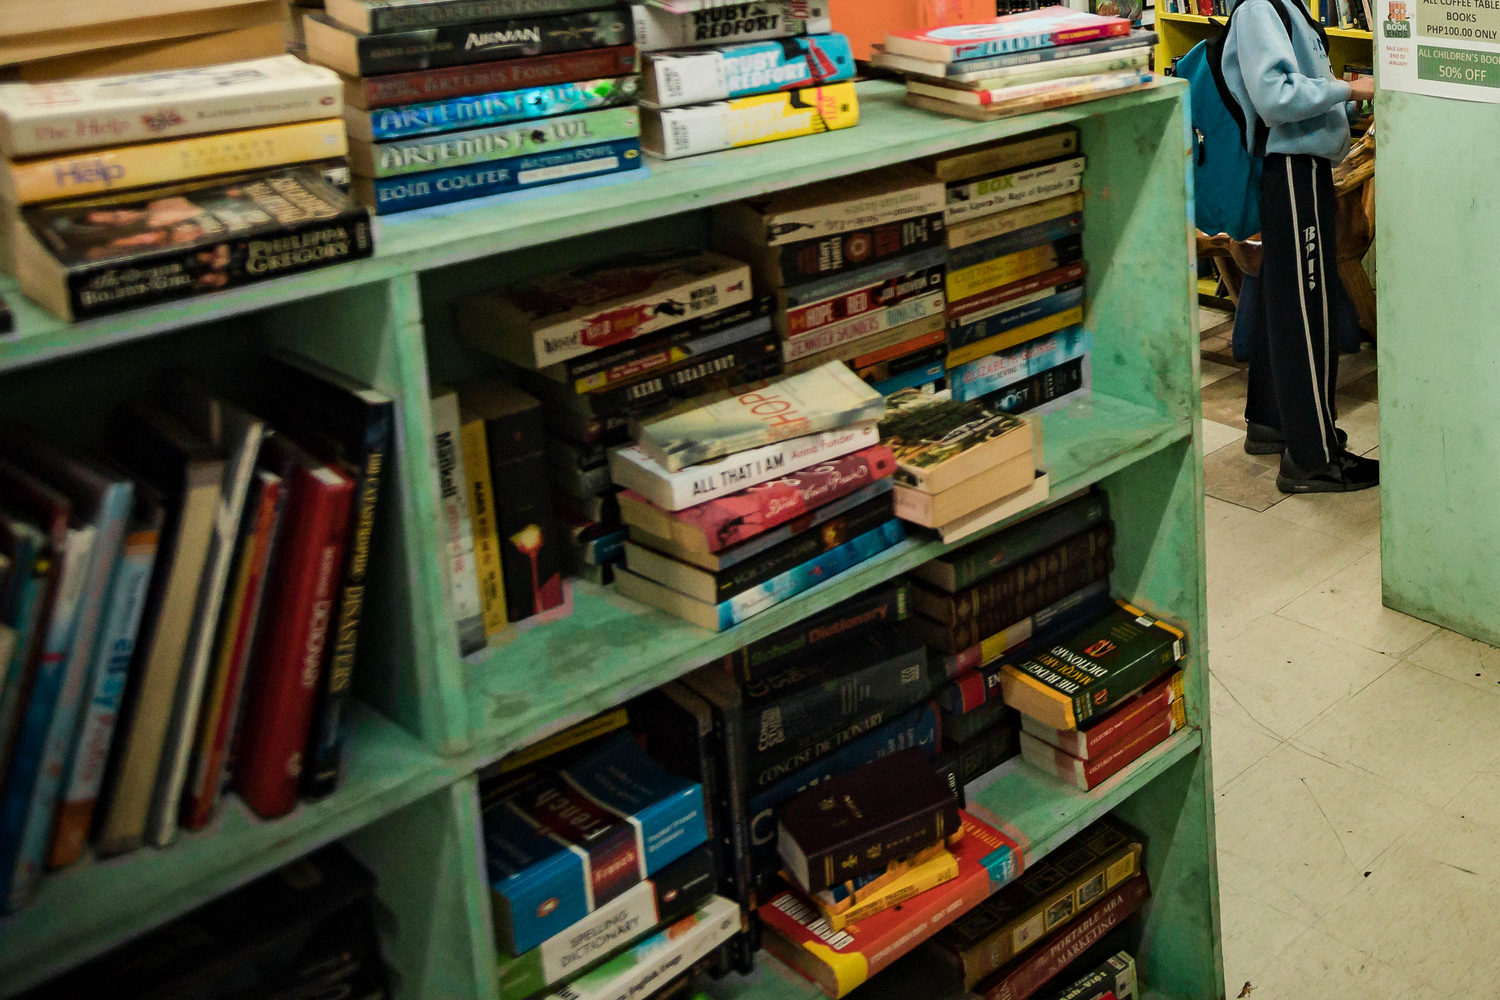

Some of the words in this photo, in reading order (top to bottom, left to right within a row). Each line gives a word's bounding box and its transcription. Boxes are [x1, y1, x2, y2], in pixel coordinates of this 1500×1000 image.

[1446, 12, 1477, 23] BOOKS
[1474, 0, 1500, 10] TABLE
[695, 14, 780, 41] REDFORT
[1386, 22, 1408, 31] BOOK
[1386, 30, 1408, 39] ENDS
[1426, 25, 1472, 38] PHP100.00
[1474, 29, 1498, 40] ONLY
[1418, 49, 1432, 59] ALL
[1433, 50, 1479, 63] CHILDREN'S
[1438, 65, 1462, 80] 50%
[1465, 69, 1487, 82] OFF
[380, 128, 510, 169] ARTEMIS
[54, 160, 127, 187] Help
[436, 168, 511, 192] COLFER
[963, 355, 1018, 384] ELIZABETH
[436, 431, 458, 500] Mankell
[693, 477, 717, 497] ALL
[720, 462, 754, 488] THAT
[756, 462, 763, 476] I
[765, 452, 785, 473] AM
[807, 604, 889, 645] Dictionary
[330, 585, 366, 694] DISASTERS
[1050, 645, 1109, 679] DICTIONARY
[1049, 912, 1100, 958] PORTABLE
[1101, 895, 1124, 918] MBA
[1057, 913, 1117, 966] MARKETING
[560, 914, 640, 970] DICTIONARY
